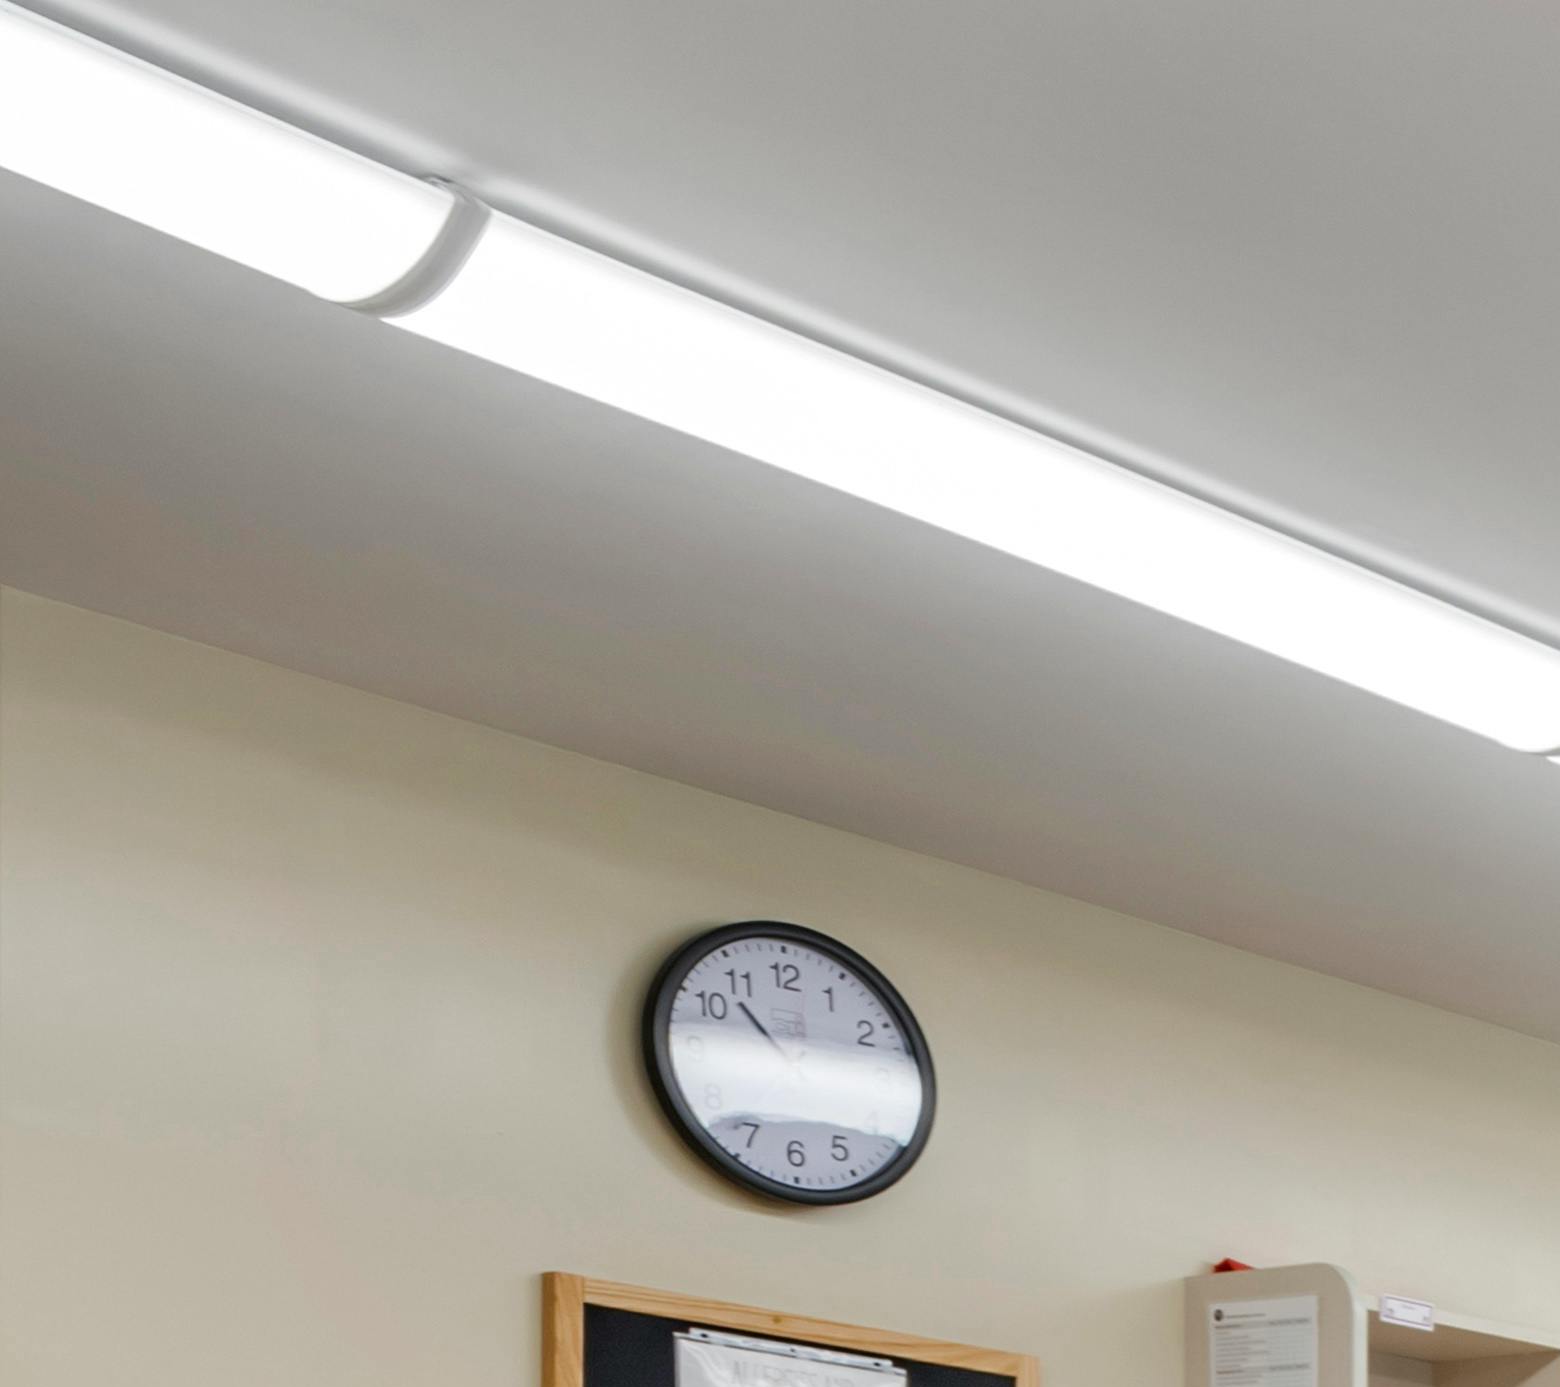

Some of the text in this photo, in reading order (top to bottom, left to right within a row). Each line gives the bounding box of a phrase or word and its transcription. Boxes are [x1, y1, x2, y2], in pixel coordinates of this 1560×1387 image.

[725, 968, 753, 998] 11
[769, 962, 802, 992] 12
[695, 990, 728, 1020] 10
[822, 986, 836, 1012] 1
[857, 1020, 876, 1047] 2
[687, 1036, 702, 1062] 9
[741, 1122, 761, 1149] 7
[831, 1135, 850, 1162] 5
[786, 1140, 806, 1168] 6
